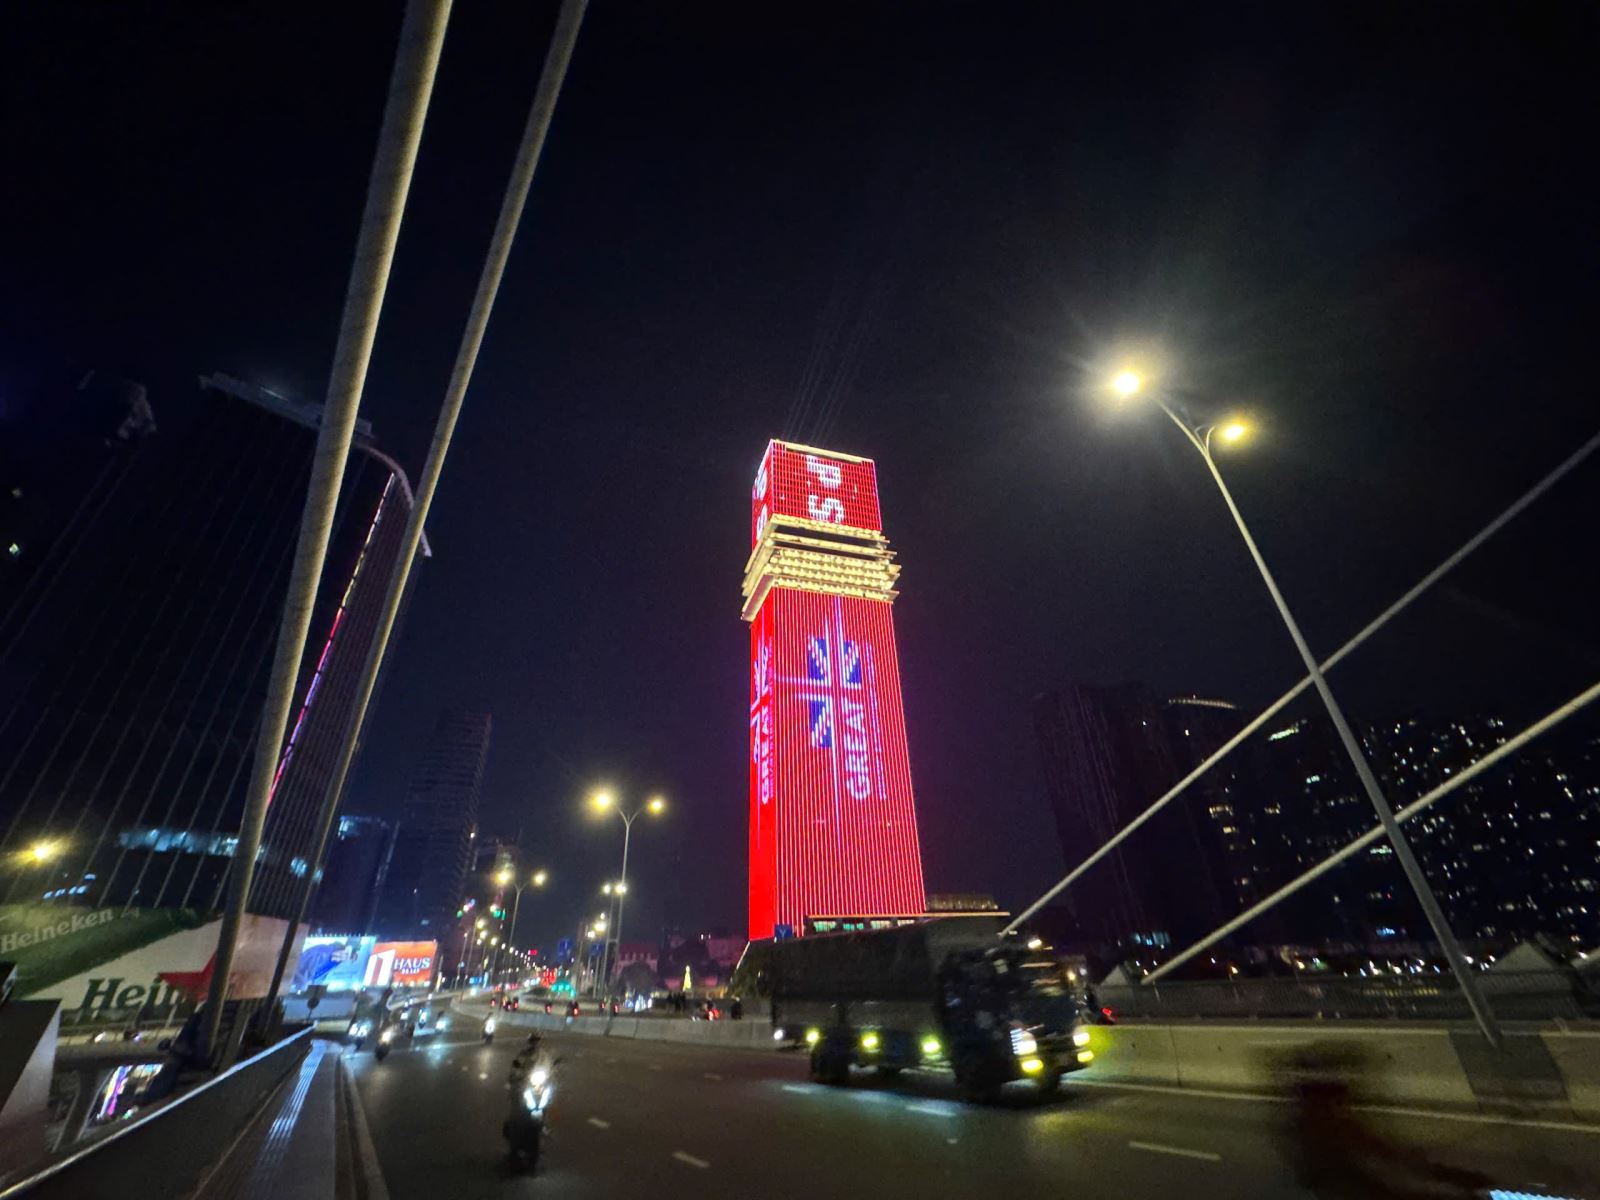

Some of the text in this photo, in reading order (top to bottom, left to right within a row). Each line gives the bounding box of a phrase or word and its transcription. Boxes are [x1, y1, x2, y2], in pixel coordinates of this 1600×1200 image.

[840, 696, 871, 801] GREAT
[1, 909, 114, 951] Heineken
[393, 957, 432, 970] HAUS
